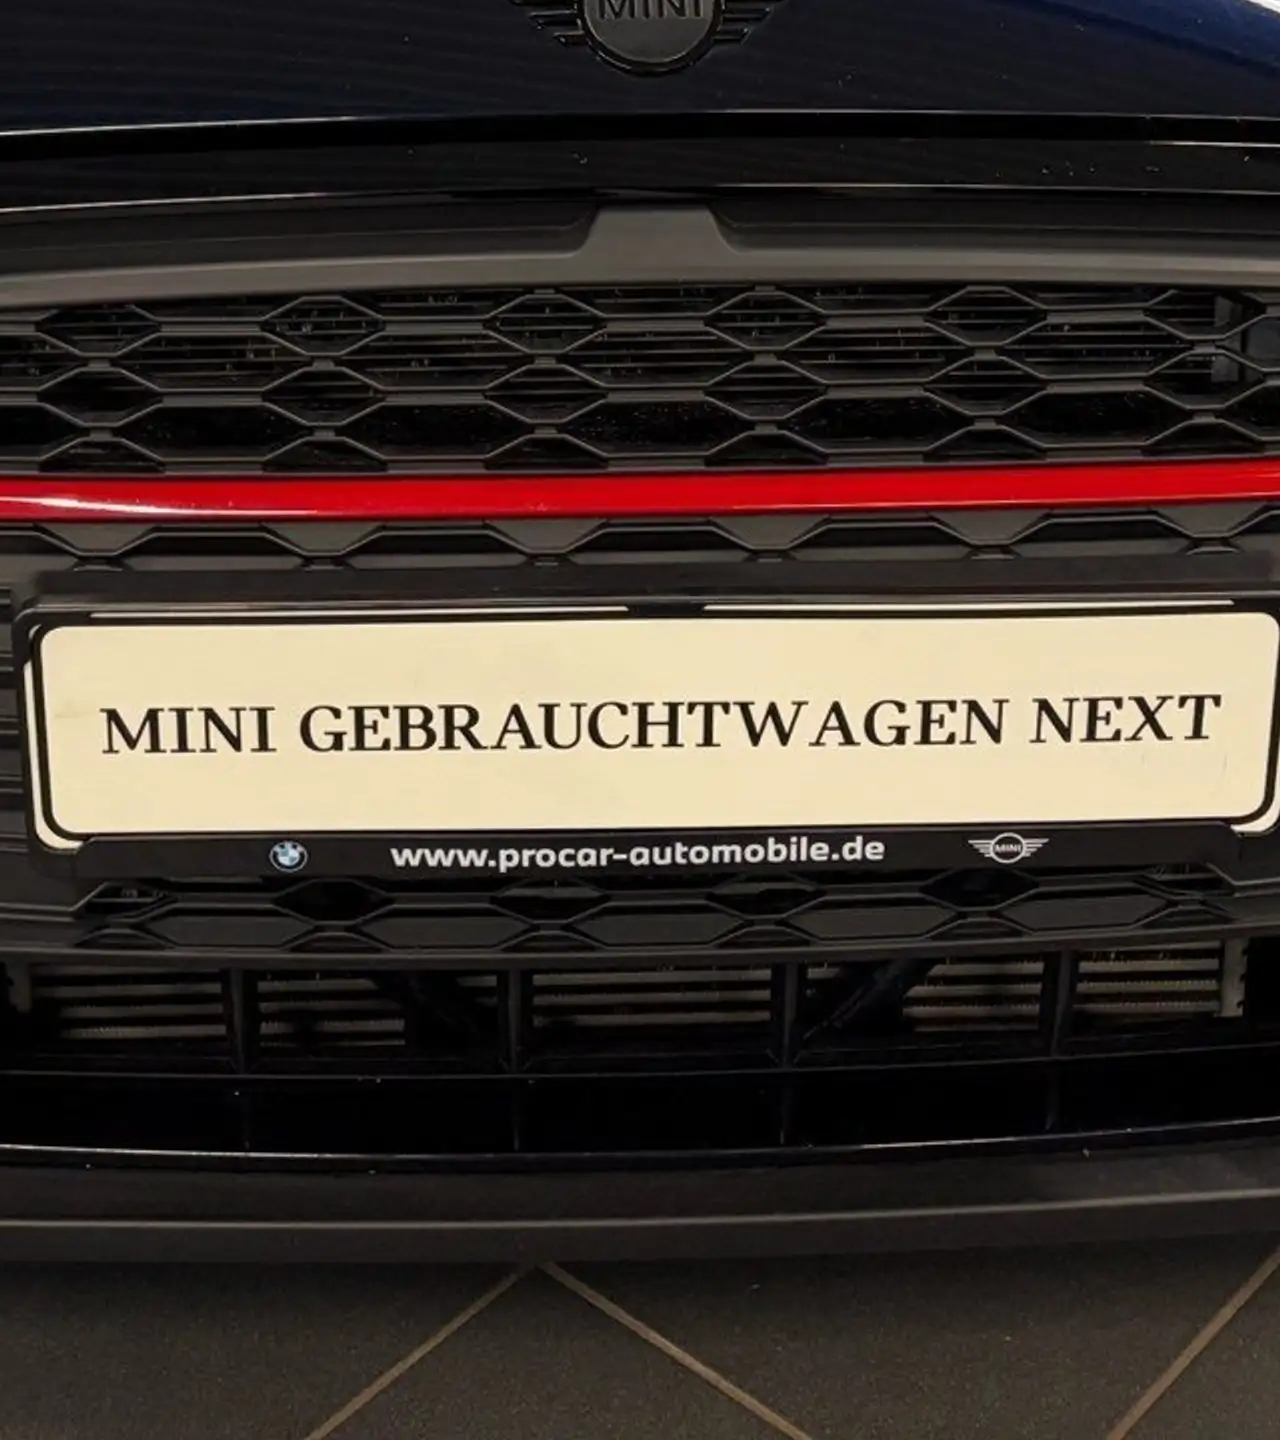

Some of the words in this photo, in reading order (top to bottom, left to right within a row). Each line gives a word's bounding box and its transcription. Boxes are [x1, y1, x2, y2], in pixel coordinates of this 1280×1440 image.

[99, 705, 278, 755] MINI
[298, 697, 1010, 753] GEBRAUCHTWAGEN
[1029, 693, 1222, 744] NEXT
[389, 835, 886, 873] www.procar-automobile.de
